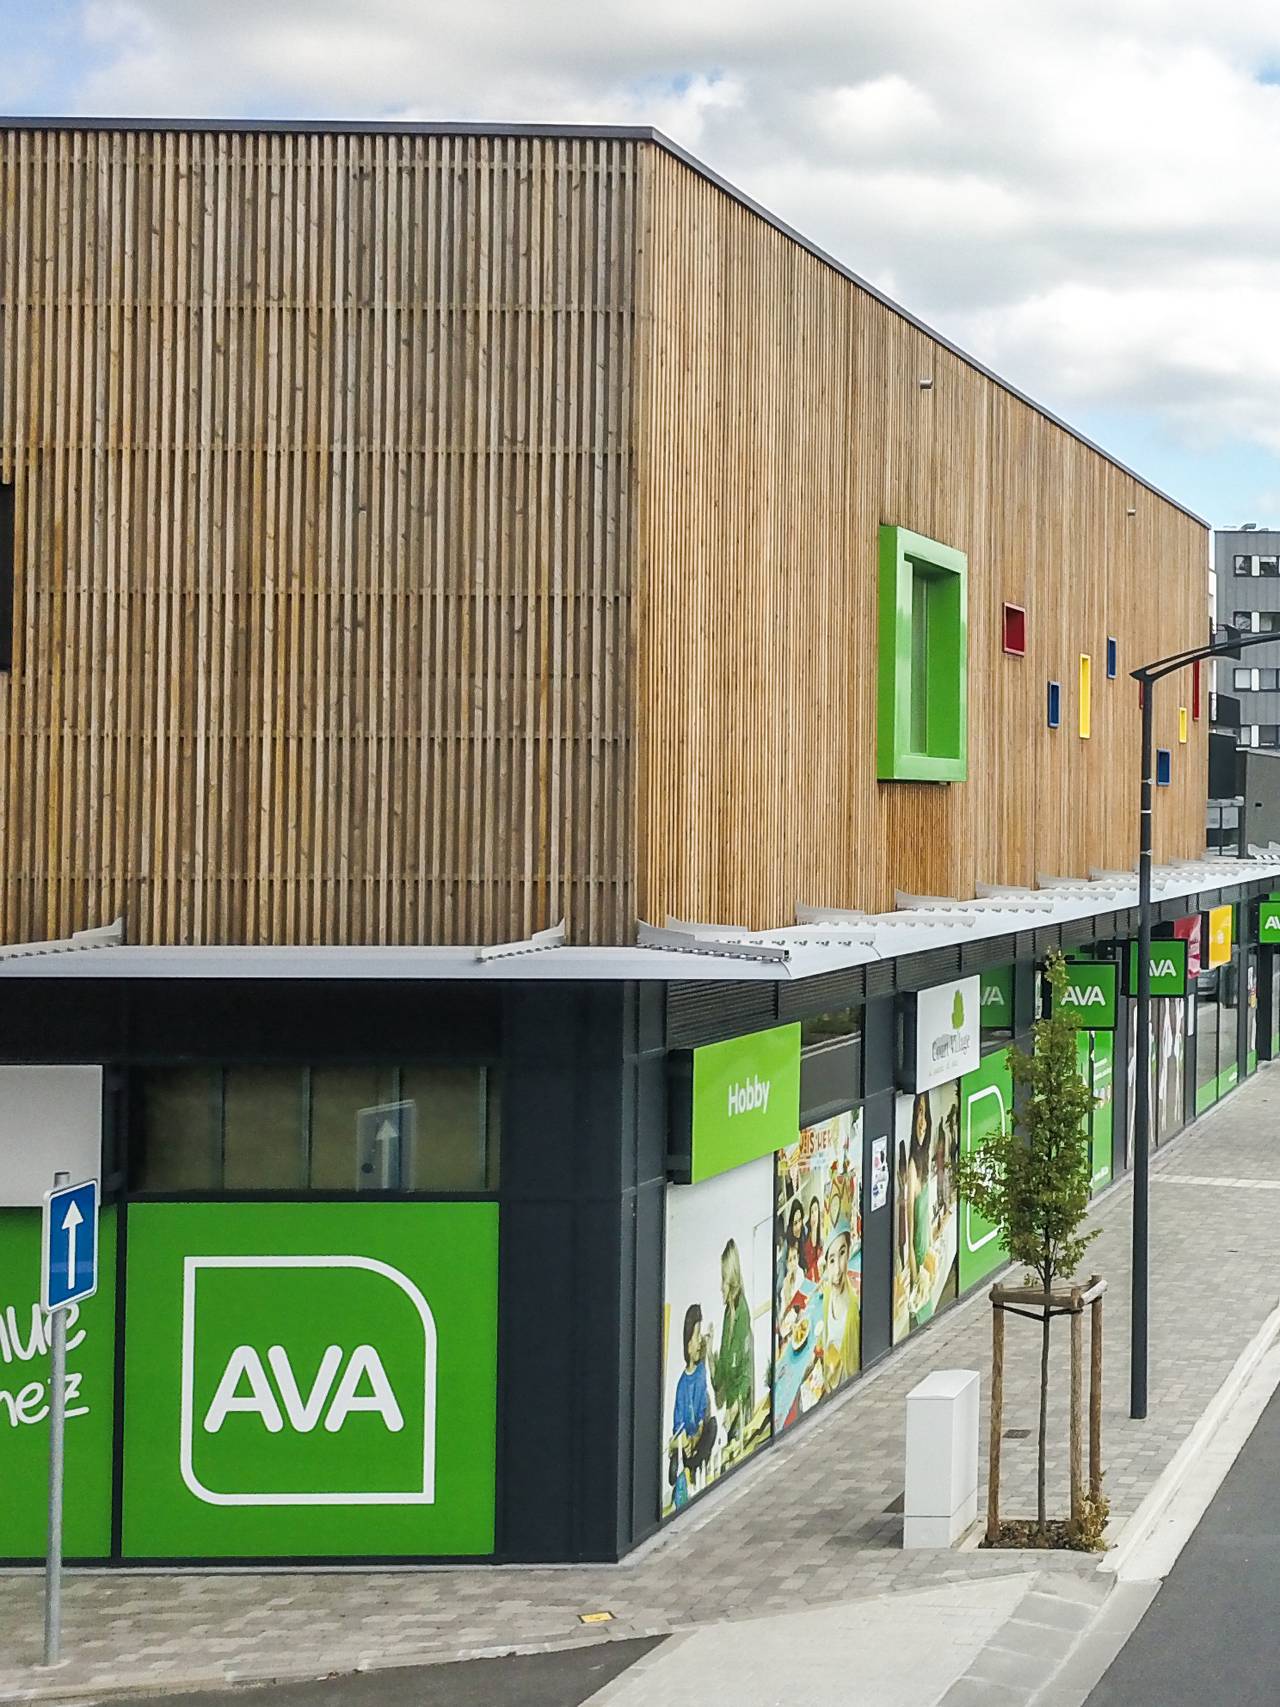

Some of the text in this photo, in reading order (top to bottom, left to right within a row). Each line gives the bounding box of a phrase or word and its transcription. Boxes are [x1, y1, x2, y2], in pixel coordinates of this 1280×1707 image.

[1061, 985, 1106, 1006] AVA
[728, 1073, 770, 1118] Hobby
[203, 1344, 405, 1433] AVA
